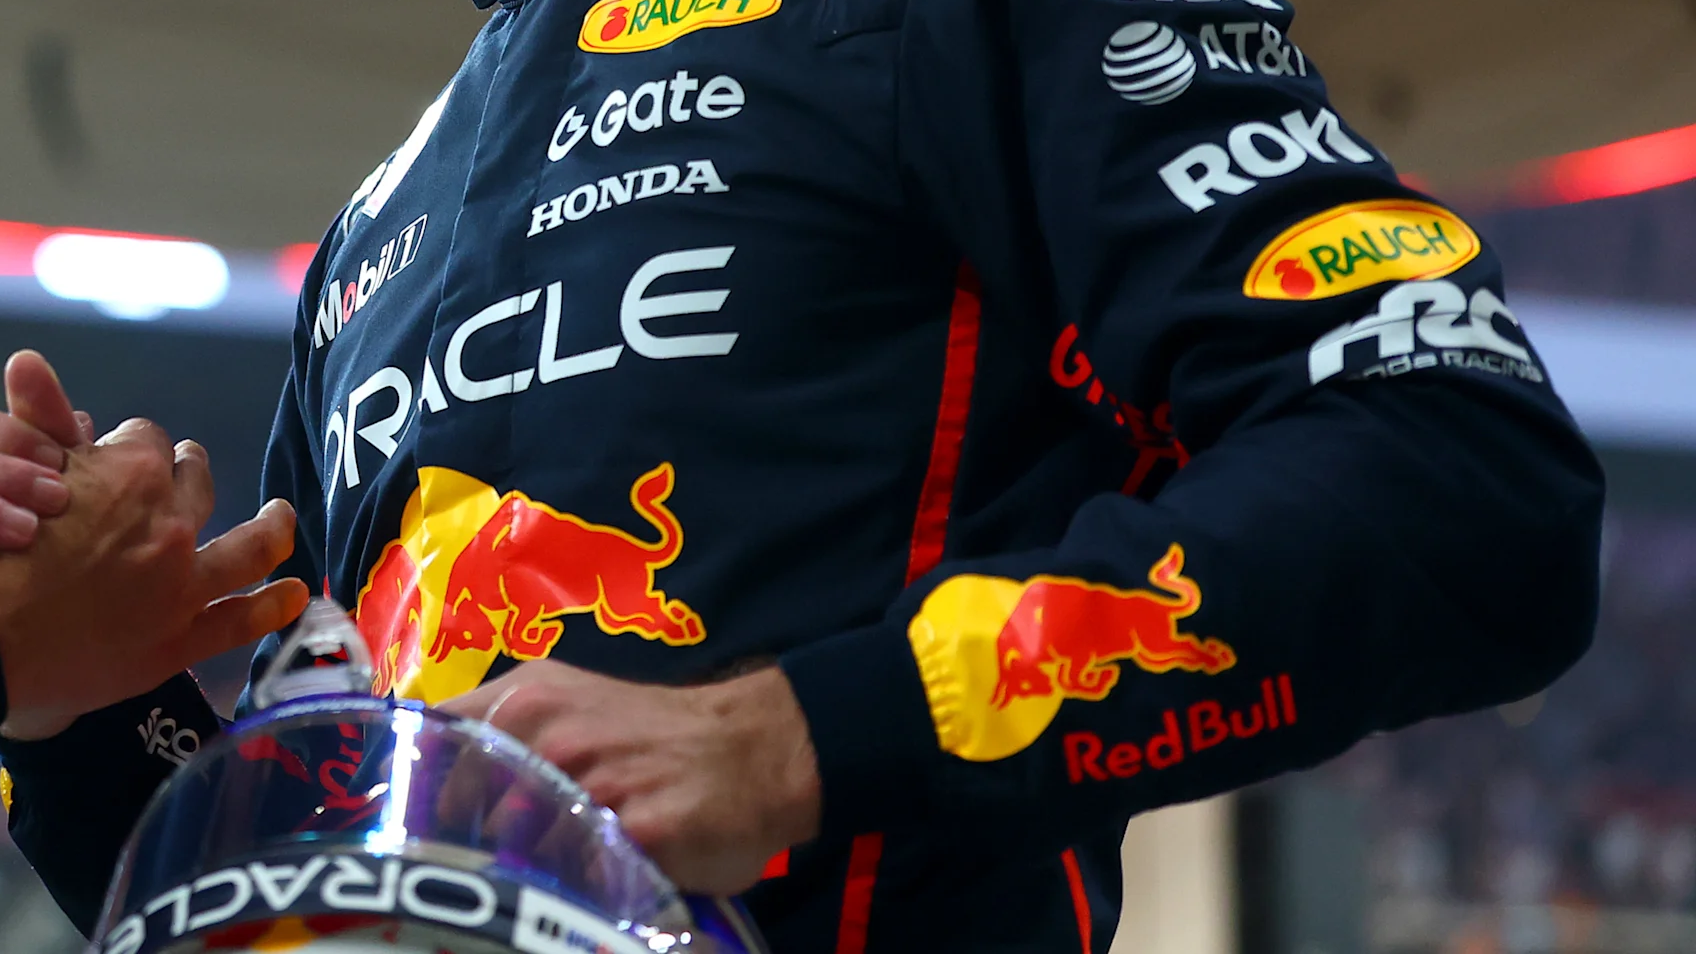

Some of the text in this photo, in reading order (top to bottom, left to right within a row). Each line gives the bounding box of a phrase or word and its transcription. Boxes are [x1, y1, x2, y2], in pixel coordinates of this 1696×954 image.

[590, 69, 746, 147] Gate
[526, 158, 730, 238] HONDA
[1309, 221, 1458, 284] RAUCH
[313, 237, 396, 350] Mobil
[104, 854, 498, 954] ORACLE
